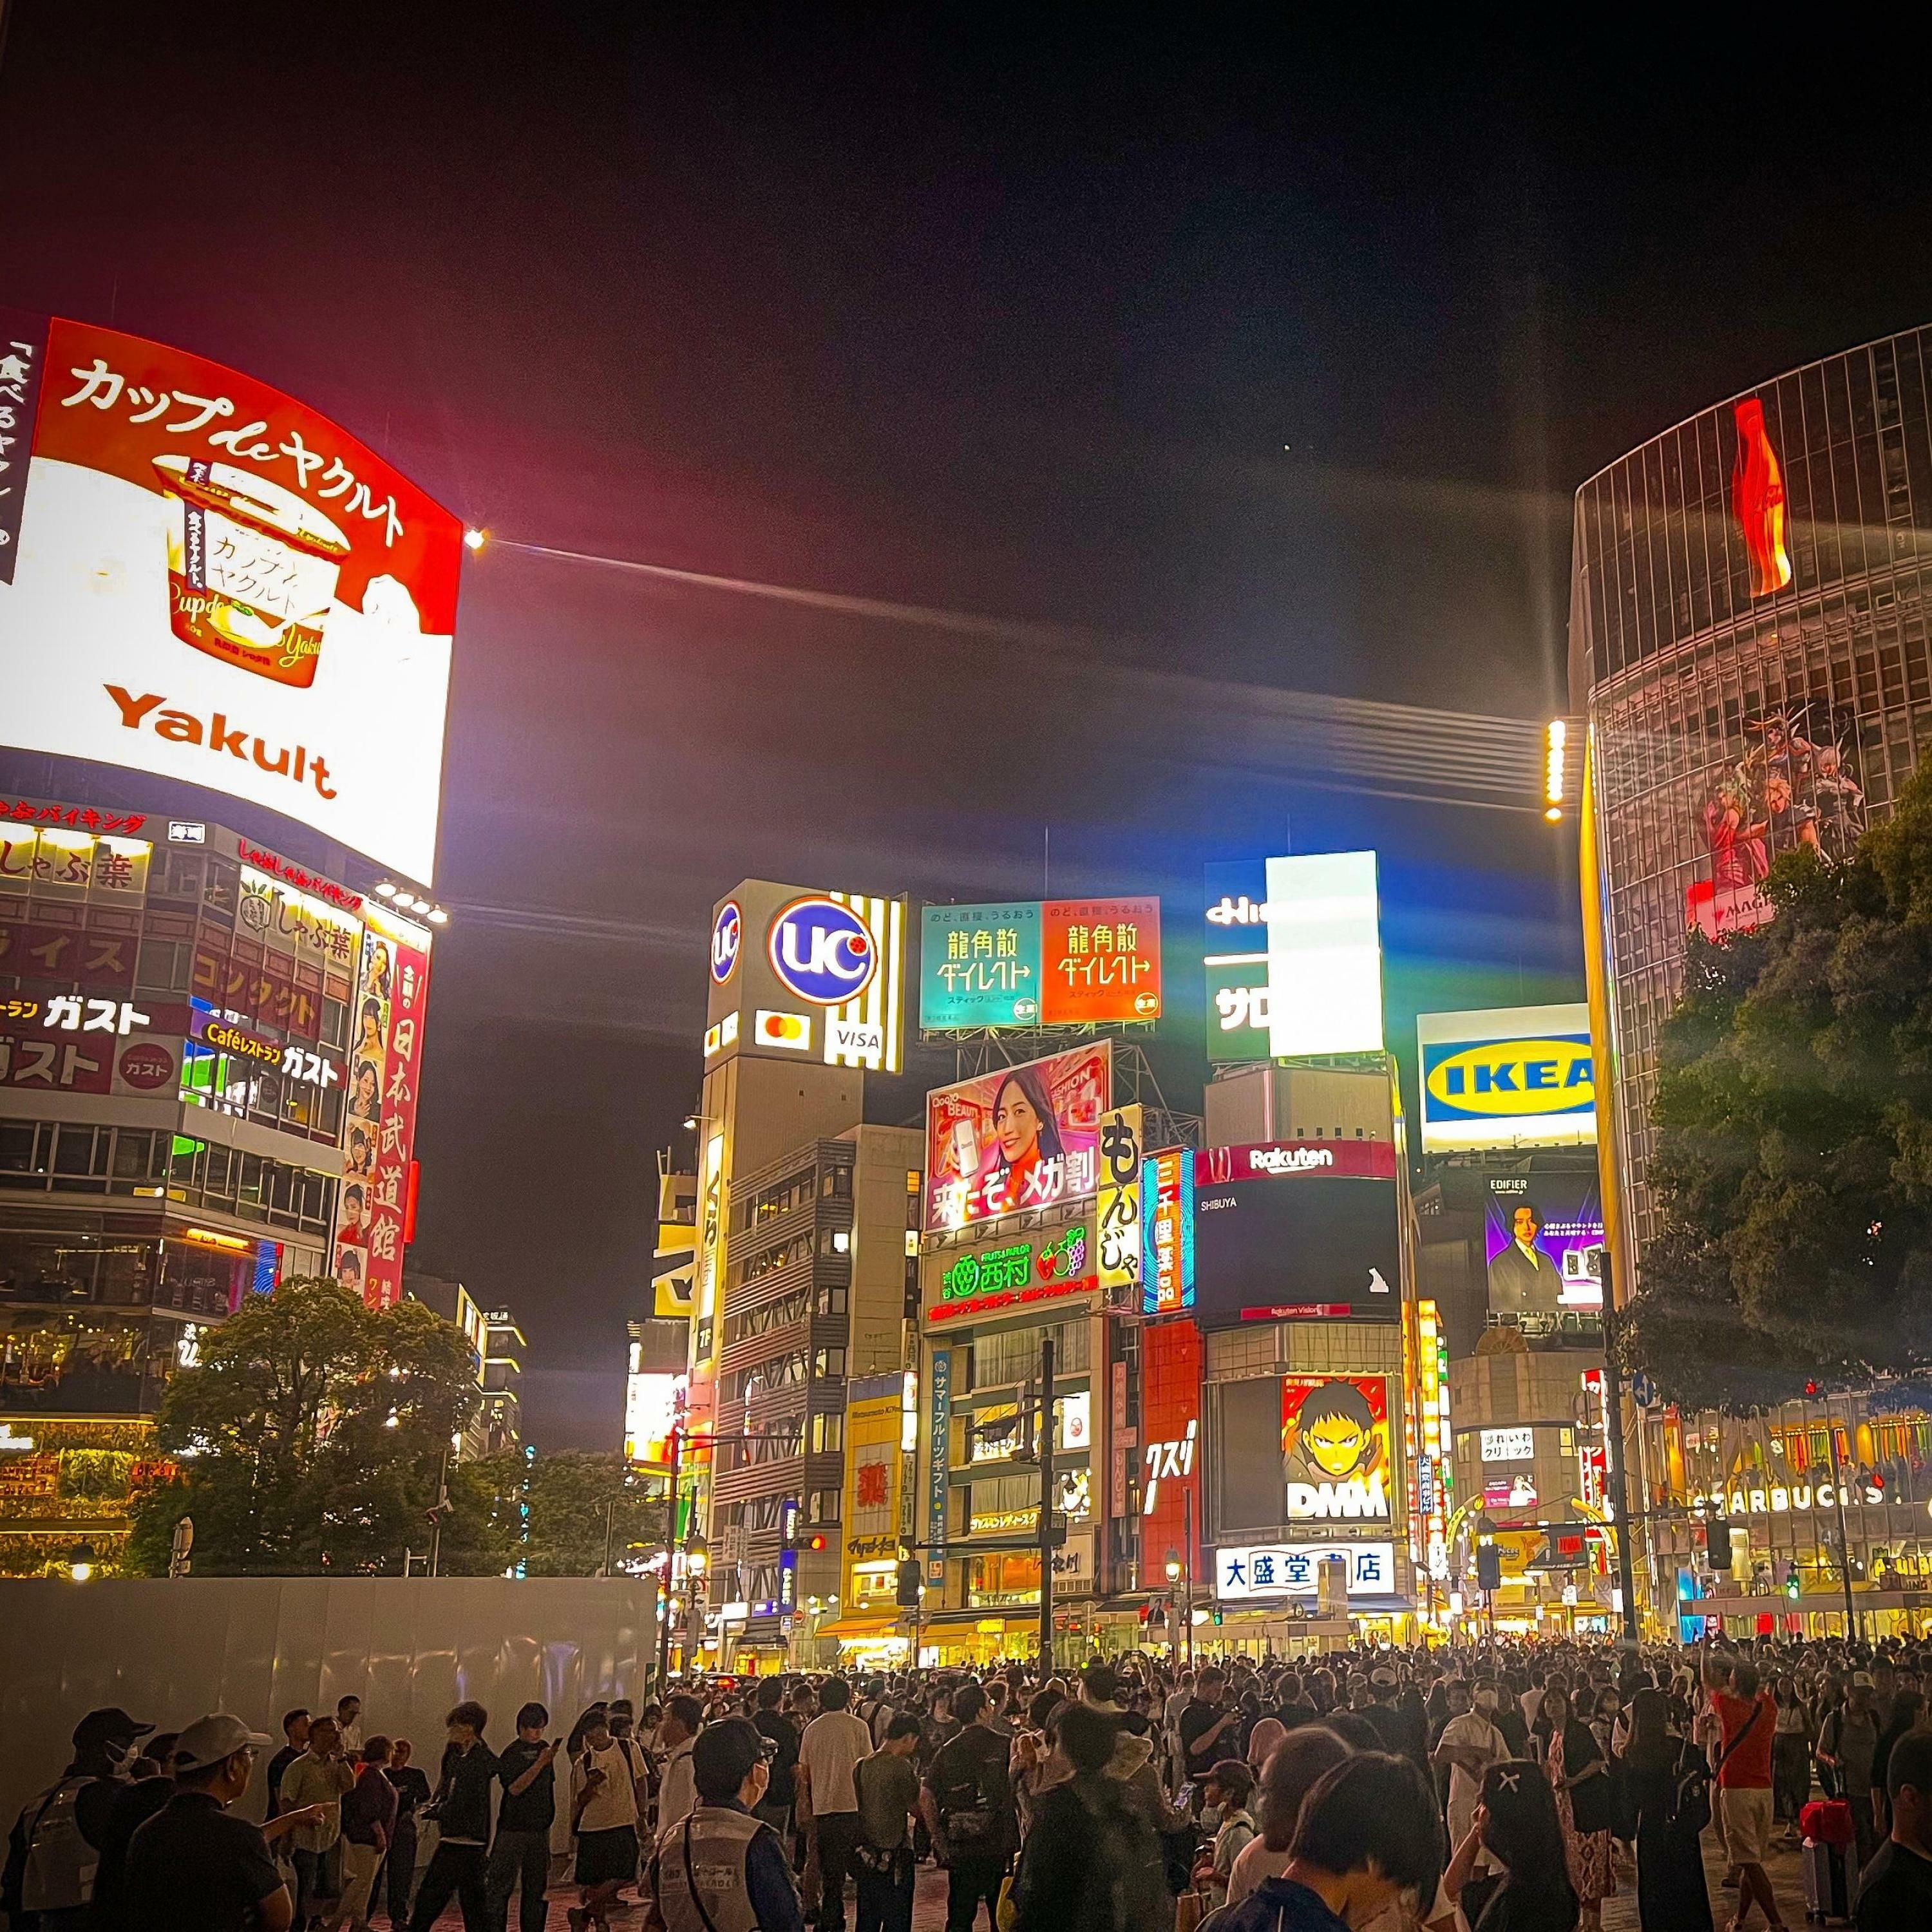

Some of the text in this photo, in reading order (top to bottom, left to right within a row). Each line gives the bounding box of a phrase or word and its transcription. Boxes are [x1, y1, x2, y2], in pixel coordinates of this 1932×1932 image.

[103, 683, 337, 800] Yakult
[0, 840, 133, 889] しゃぶ葉
[279, 900, 351, 960] しゃぶ葉
[947, 928, 1018, 960] 龍角散
[1067, 923, 1138, 954] 龍角散
[194, 953, 314, 1025] コンタクト
[936, 962, 1030, 992] ダイレクト
[1057, 956, 1150, 987] ダイレクト
[43, 996, 150, 1035] ガスト
[837, 1029, 879, 1049] VISA
[126, 1063, 168, 1077] ガスト
[281, 1046, 338, 1088] ガスト
[370, 1019, 415, 1262] 日本武道館
[1249, 1148, 1332, 1170] Rakuten
[1101, 1113, 1139, 1279] もんじゃ
[1490, 1179, 1528, 1190] EDIFIER
[1201, 1198, 1236, 1211] SHIBUYA
[981, 1256, 1030, 1293] 西村
[933, 1376, 947, 1498] サマーフルーツギフト
[1286, 1482, 1388, 1518] DMM
[1226, 1553, 1381, 1587] 大盛堂店
